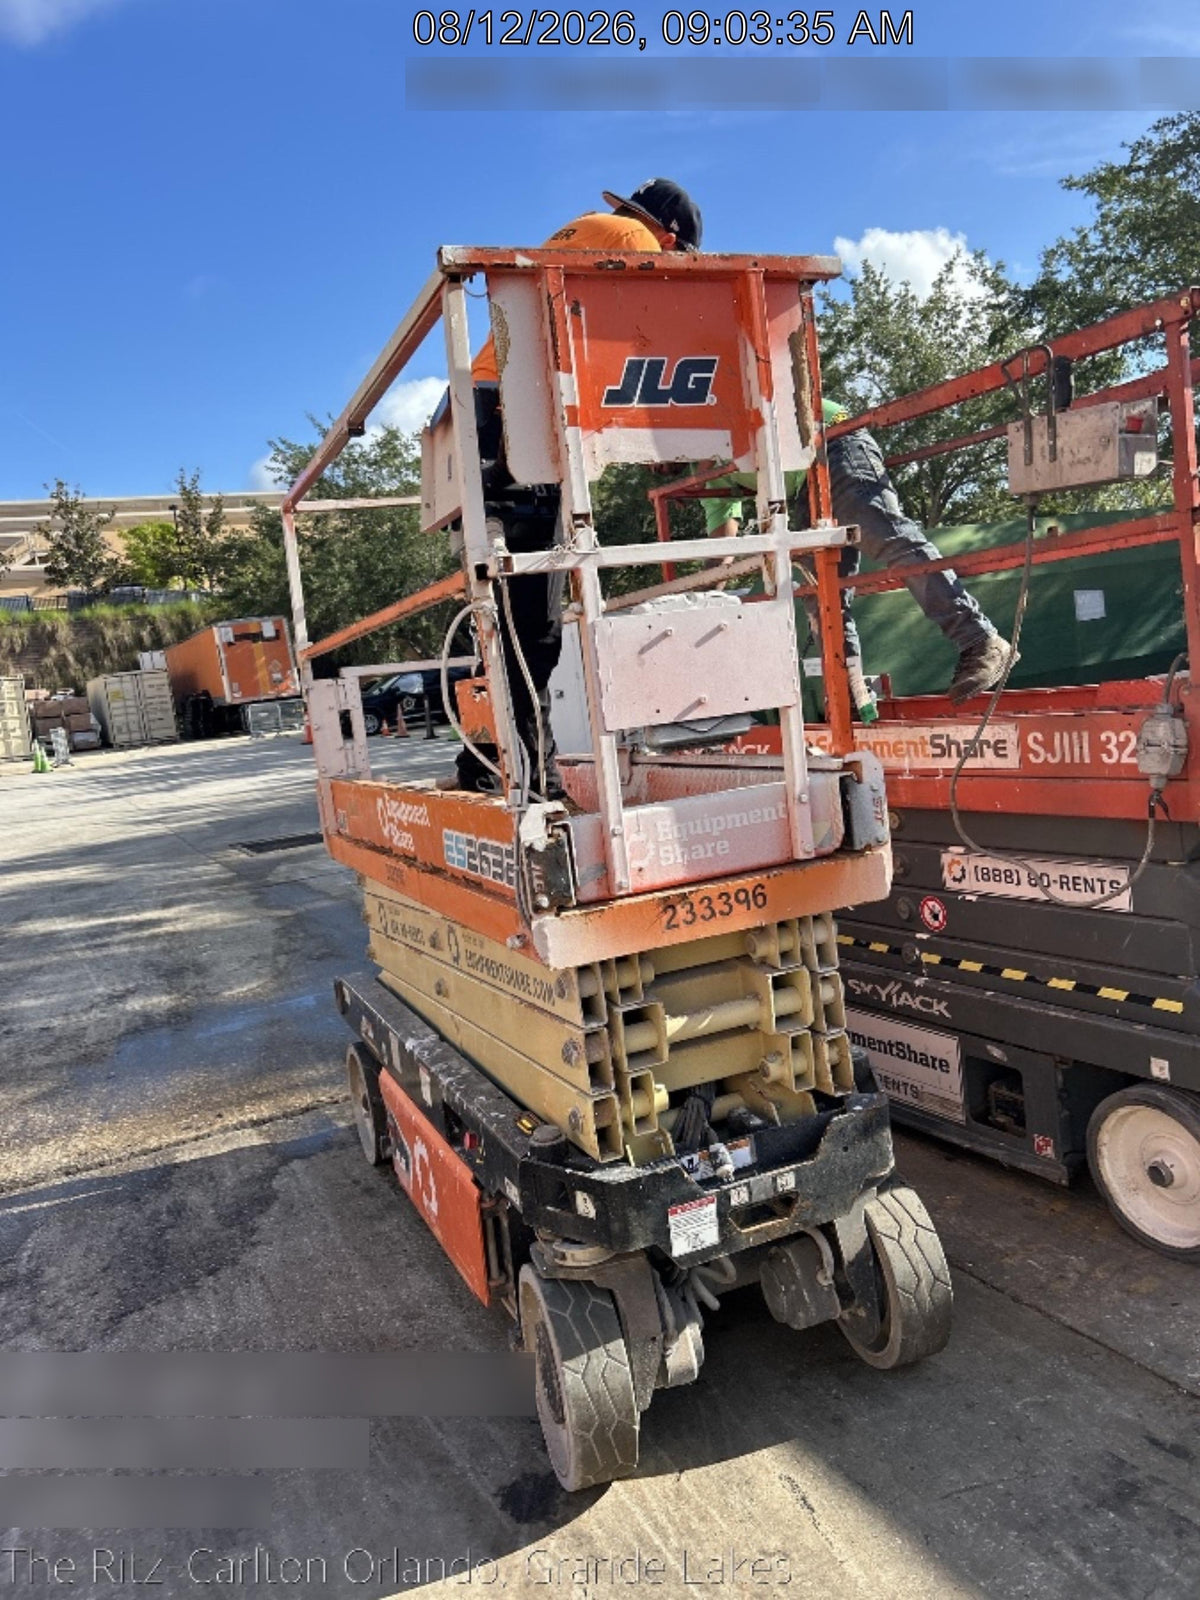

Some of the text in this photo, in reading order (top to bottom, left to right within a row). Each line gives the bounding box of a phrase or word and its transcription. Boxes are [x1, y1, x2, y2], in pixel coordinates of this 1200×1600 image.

[601, 356, 719, 407] JLG
[655, 803, 787, 843] Equipment
[658, 839, 730, 867] Share
[974, 865, 1021, 886] (888)
[662, 882, 768, 931] 233396
[845, 1028, 951, 1073] mentShare
